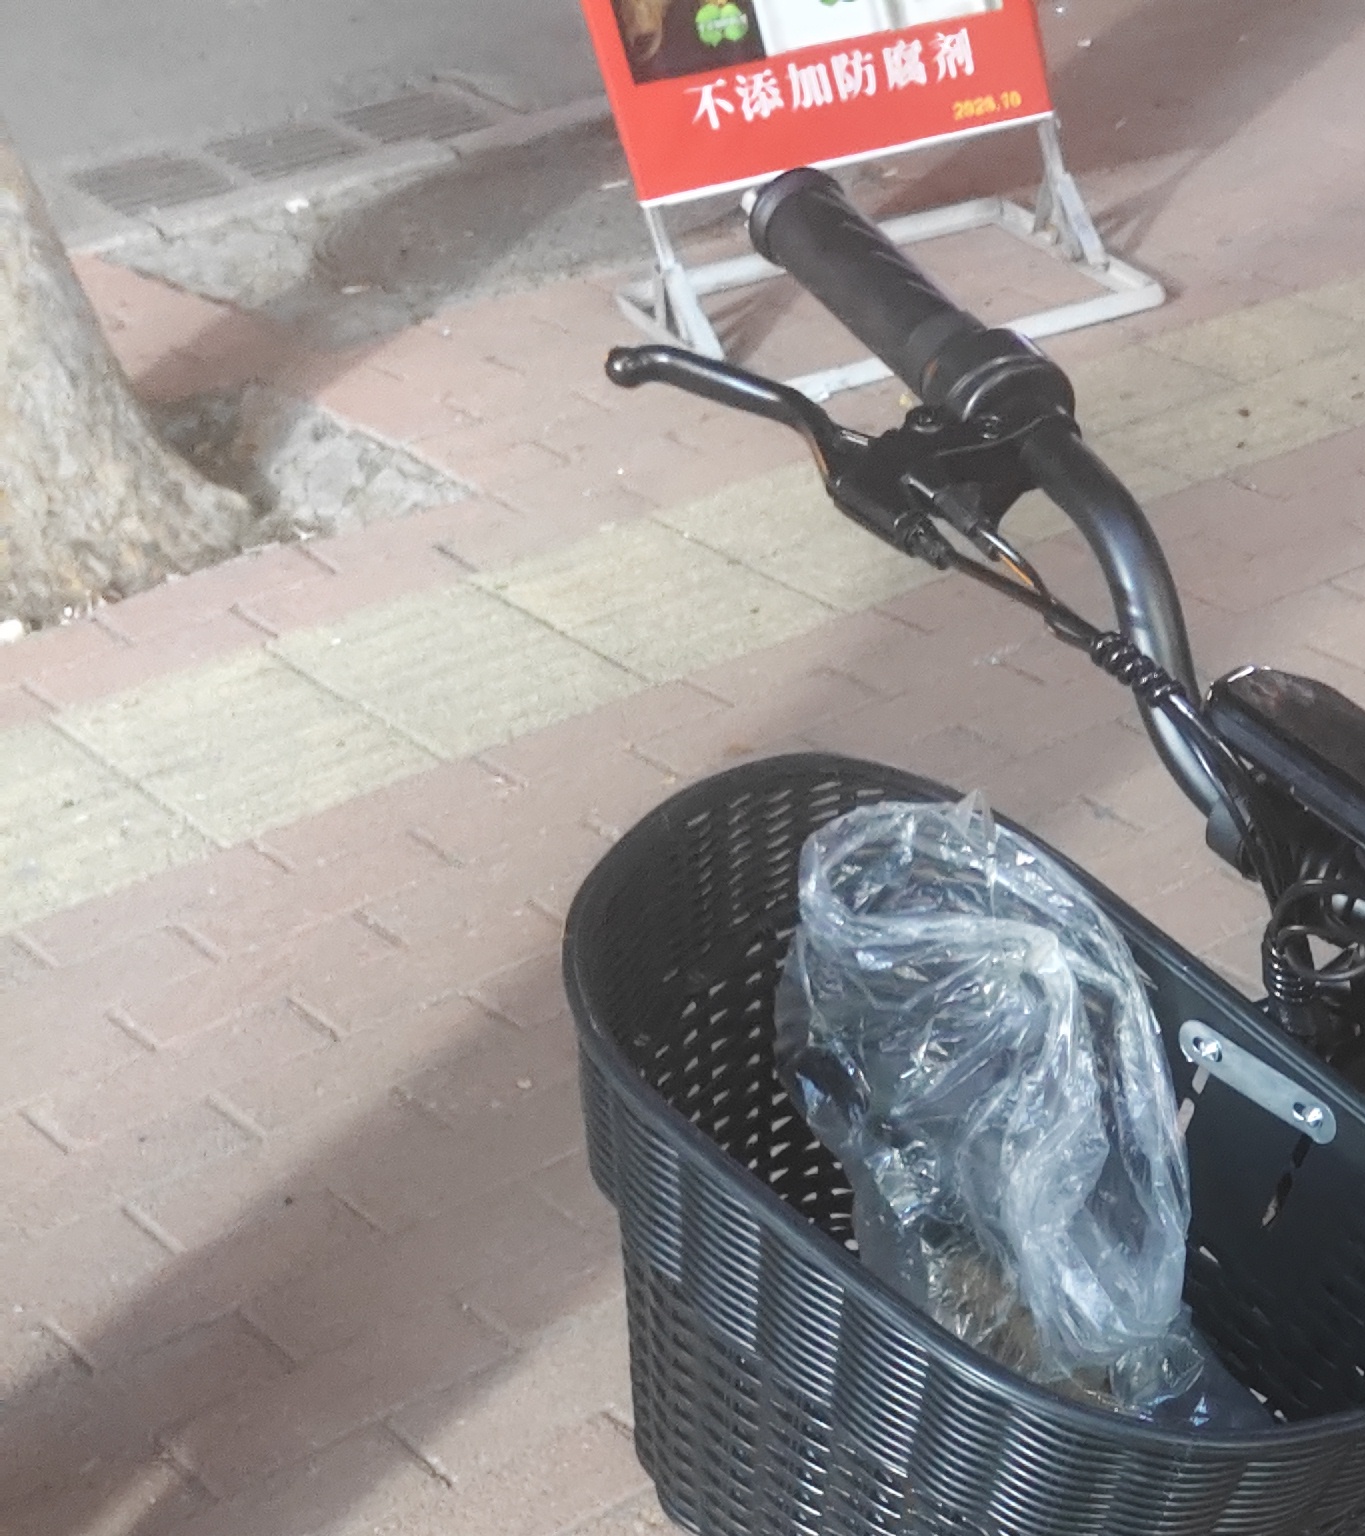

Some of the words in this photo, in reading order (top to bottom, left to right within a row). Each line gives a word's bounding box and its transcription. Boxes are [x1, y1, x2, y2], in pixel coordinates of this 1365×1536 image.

[685, 27, 976, 130] 不添加防腐剂
